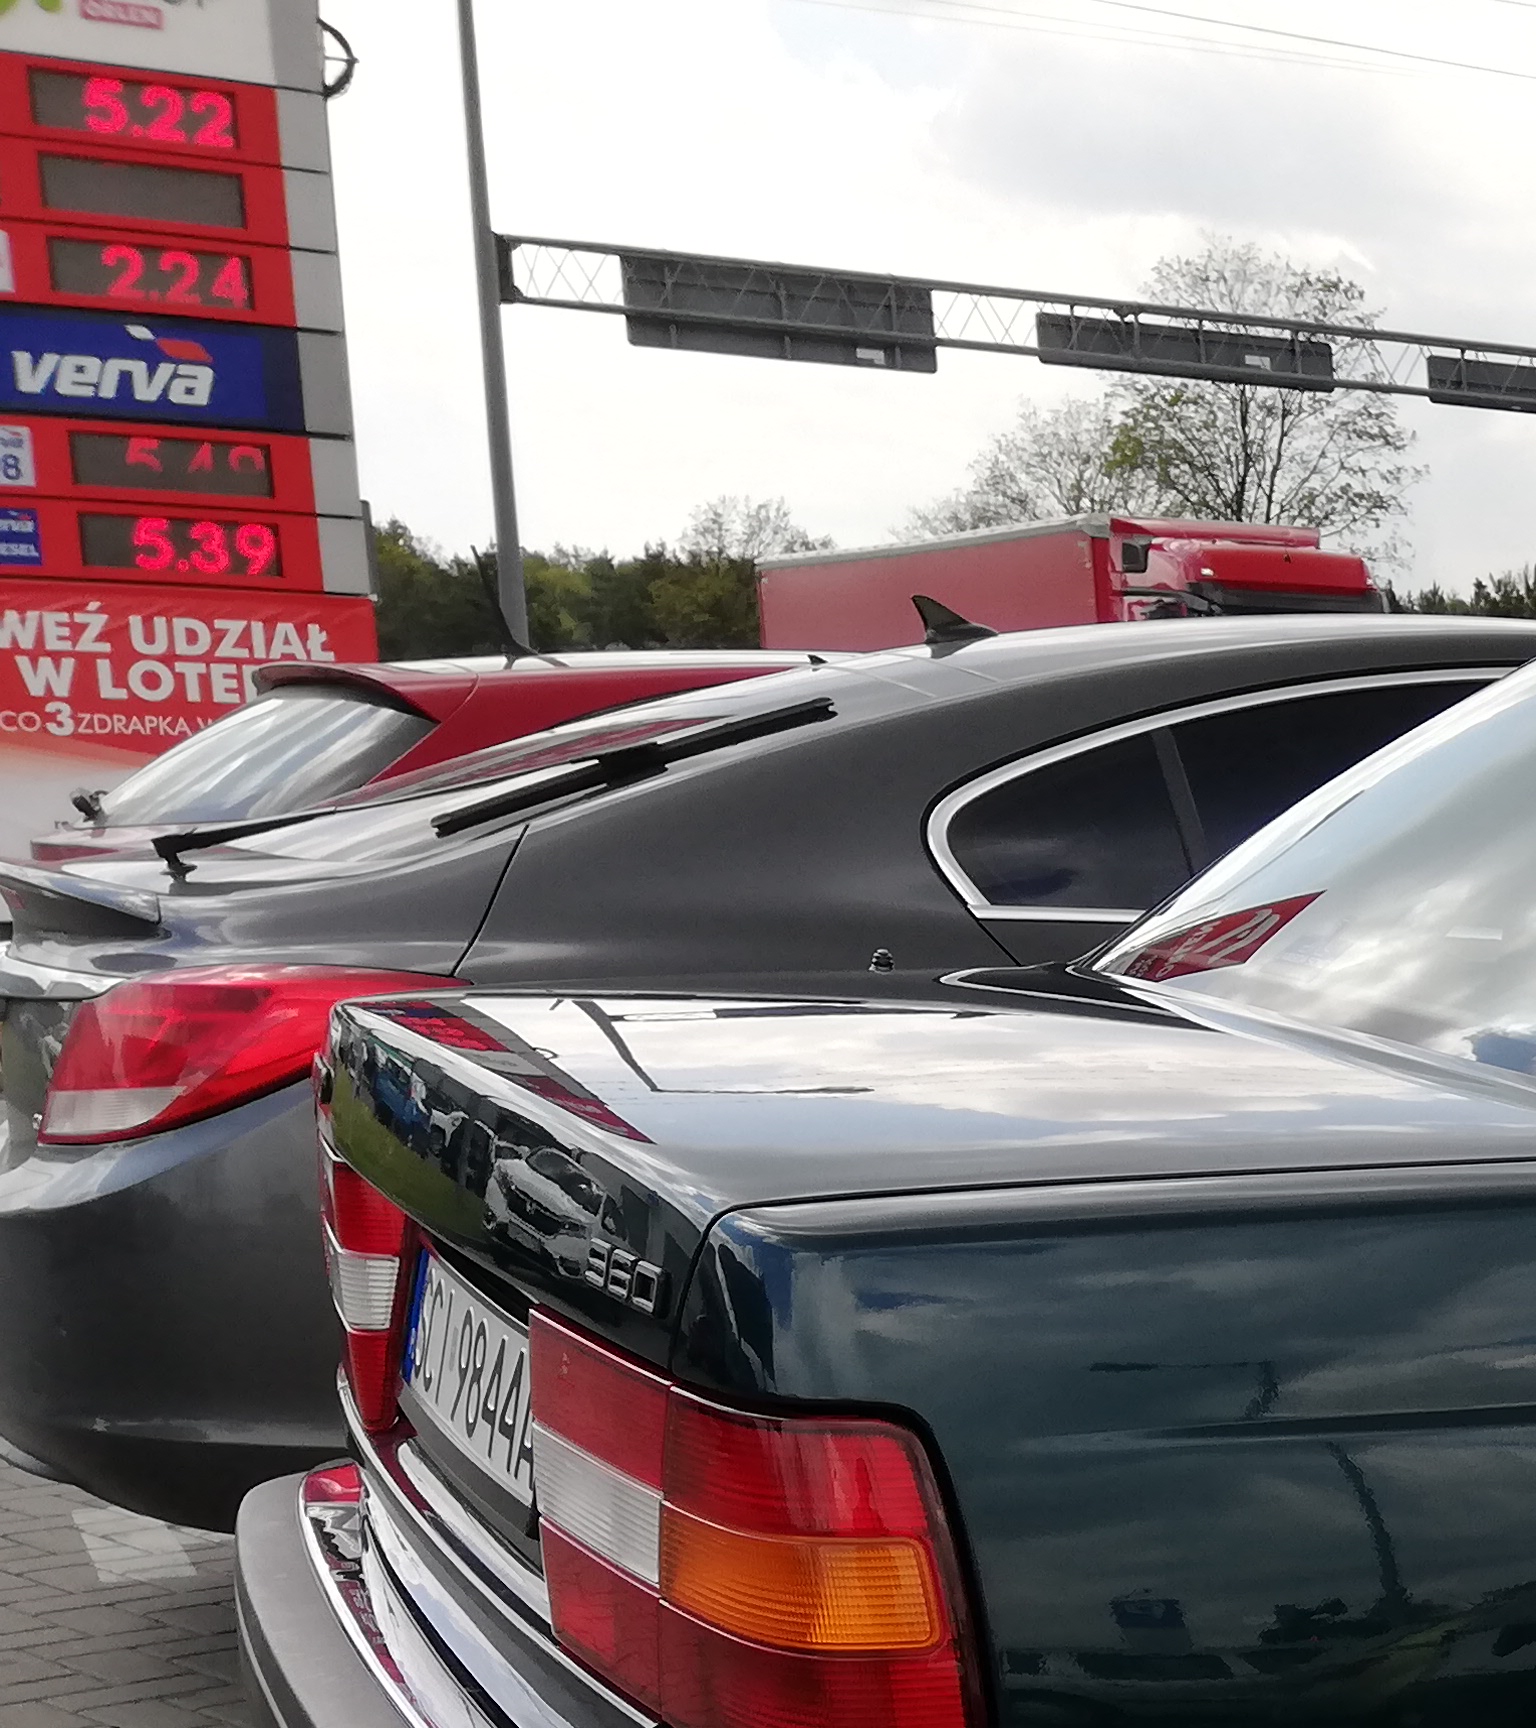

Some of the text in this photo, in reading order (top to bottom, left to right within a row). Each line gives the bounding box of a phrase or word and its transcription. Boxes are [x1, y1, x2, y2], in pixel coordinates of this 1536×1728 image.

[82, 77, 235, 148] 5.22
[101, 244, 250, 309] 2.24
[10, 350, 215, 406] verva
[132, 516, 277, 575] 5.39
[128, 615, 335, 662] UDZIAŁ
[14, 655, 75, 698] W
[0, 710, 42, 732] CO
[45, 701, 75, 737] 3
[77, 713, 192, 737] ZDRAPKA
